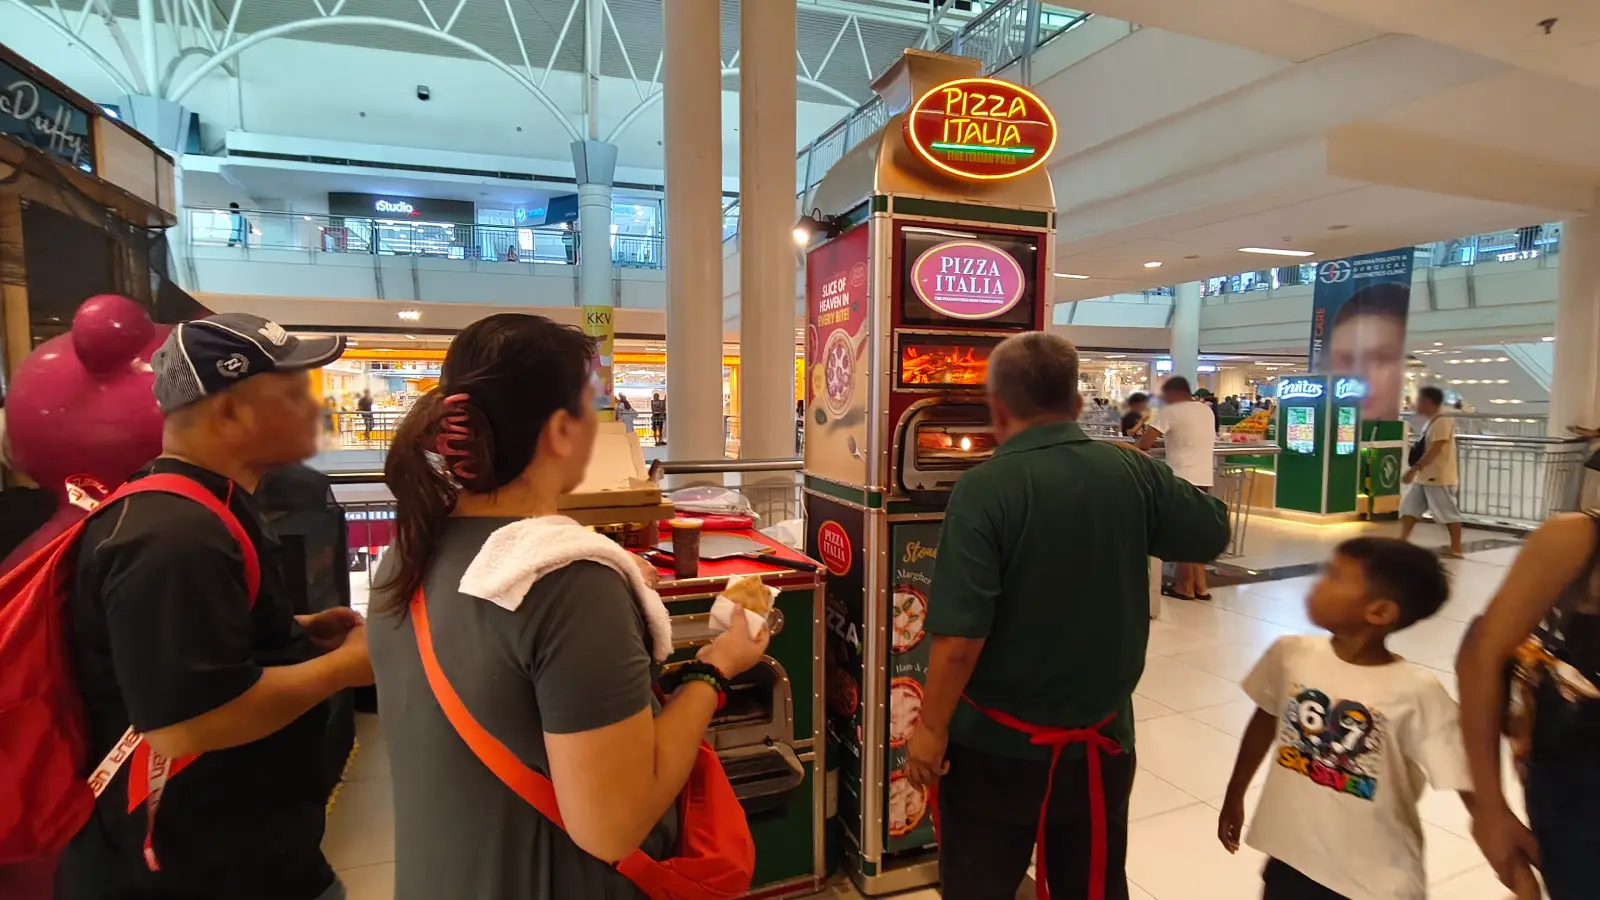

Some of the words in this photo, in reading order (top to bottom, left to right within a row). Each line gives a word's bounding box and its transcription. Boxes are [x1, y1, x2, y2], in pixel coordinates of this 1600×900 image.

[942, 87, 1027, 118] PIZZA
[943, 118, 1021, 146] ITALIA
[375, 200, 414, 213] iStudio
[940, 256, 1000, 277] PIZZA
[1353, 262, 1406, 272] SURGICAL
[822, 280, 837, 297] SLICE
[838, 277, 846, 292] OF
[935, 275, 1004, 295] ITALIA
[820, 294, 841, 312] HEAVEN
[842, 292, 850, 307] IN
[587, 312, 611, 324] KKV
[818, 312, 835, 327] EVERY
[1315, 308, 1325, 337] CARE
[1277, 379, 1323, 398] Fruitas
[824, 529, 844, 548] PIZZA
[824, 540, 845, 562] ITALIA
[827, 605, 859, 648] ZZA
[896, 664, 912, 674] Ham
[1300, 700, 1325, 730] 6
[1339, 718, 1365, 751] 7
